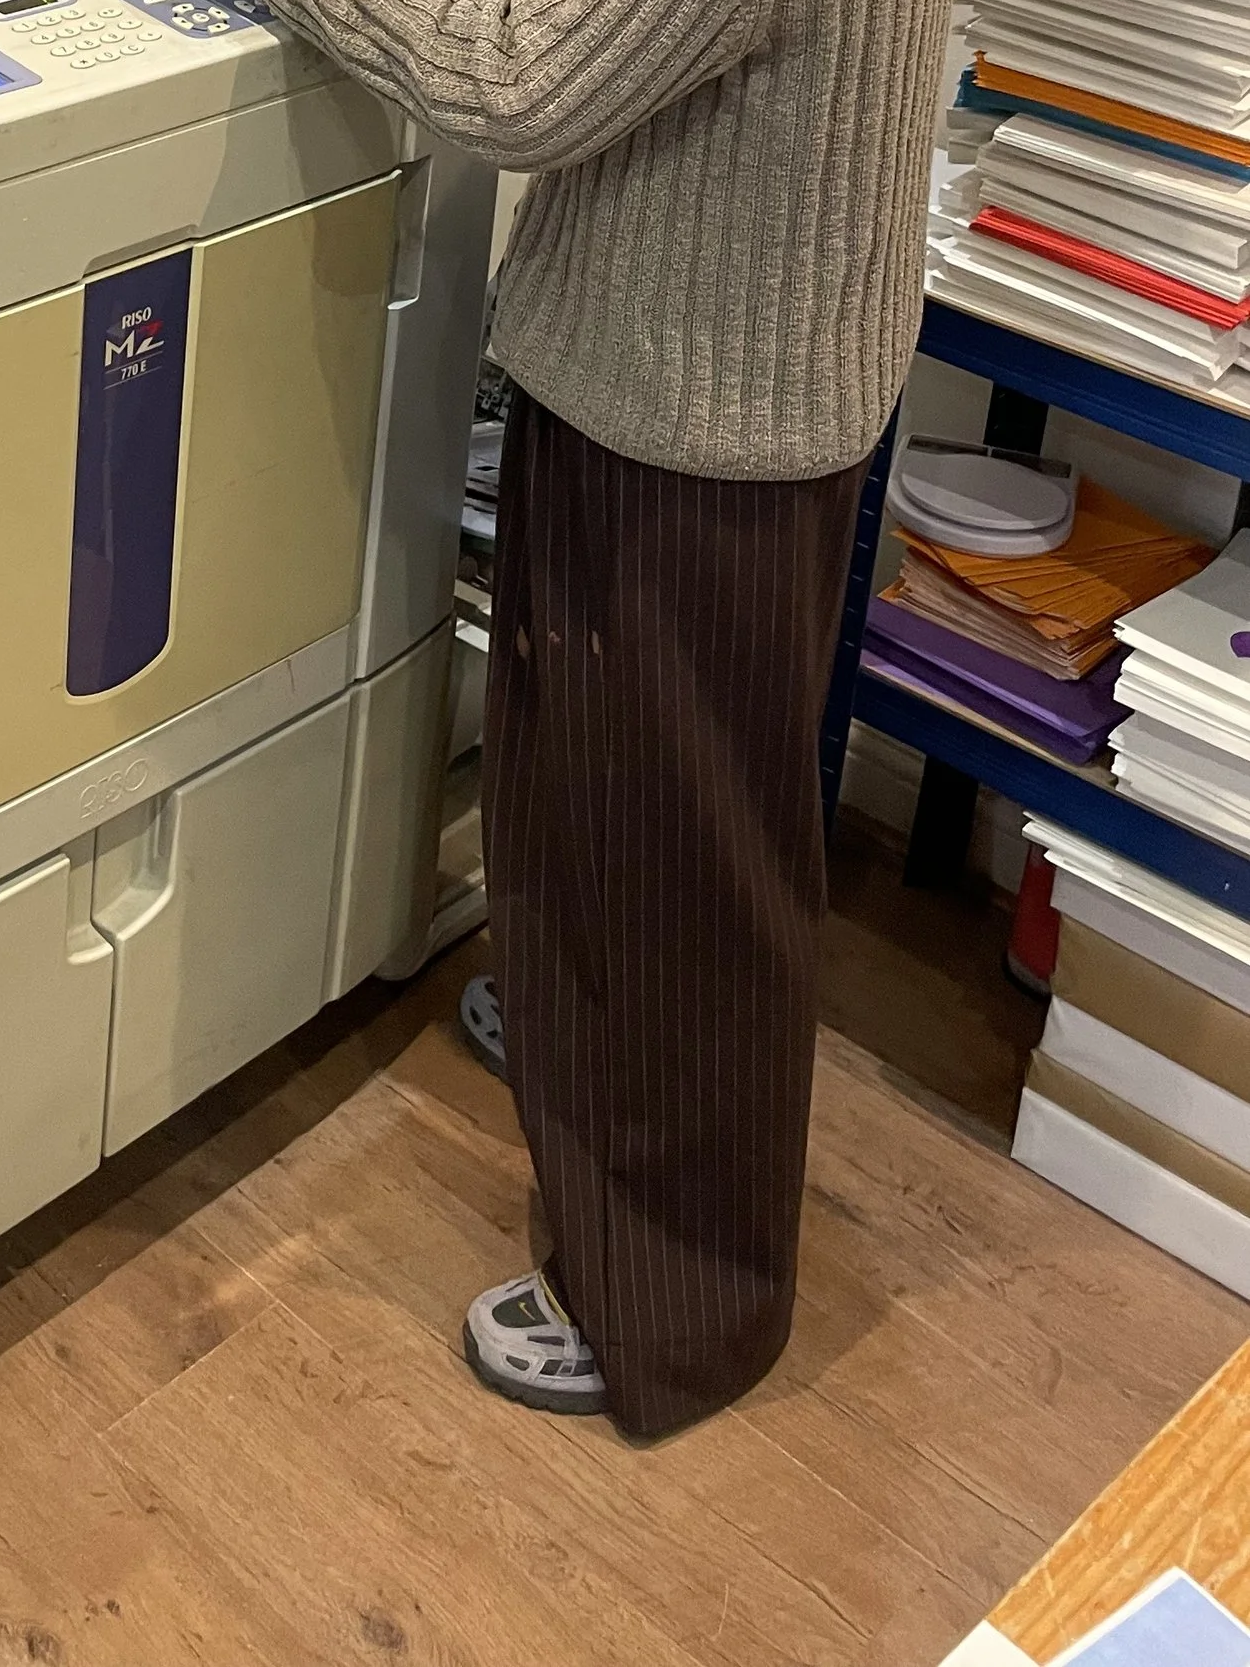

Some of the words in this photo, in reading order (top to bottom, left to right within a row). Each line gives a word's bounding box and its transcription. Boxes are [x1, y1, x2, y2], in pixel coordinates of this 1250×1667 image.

[121, 306, 152, 330] RISO
[121, 363, 138, 380] 770
[140, 359, 147, 372] E
[79, 757, 150, 819] RISO
